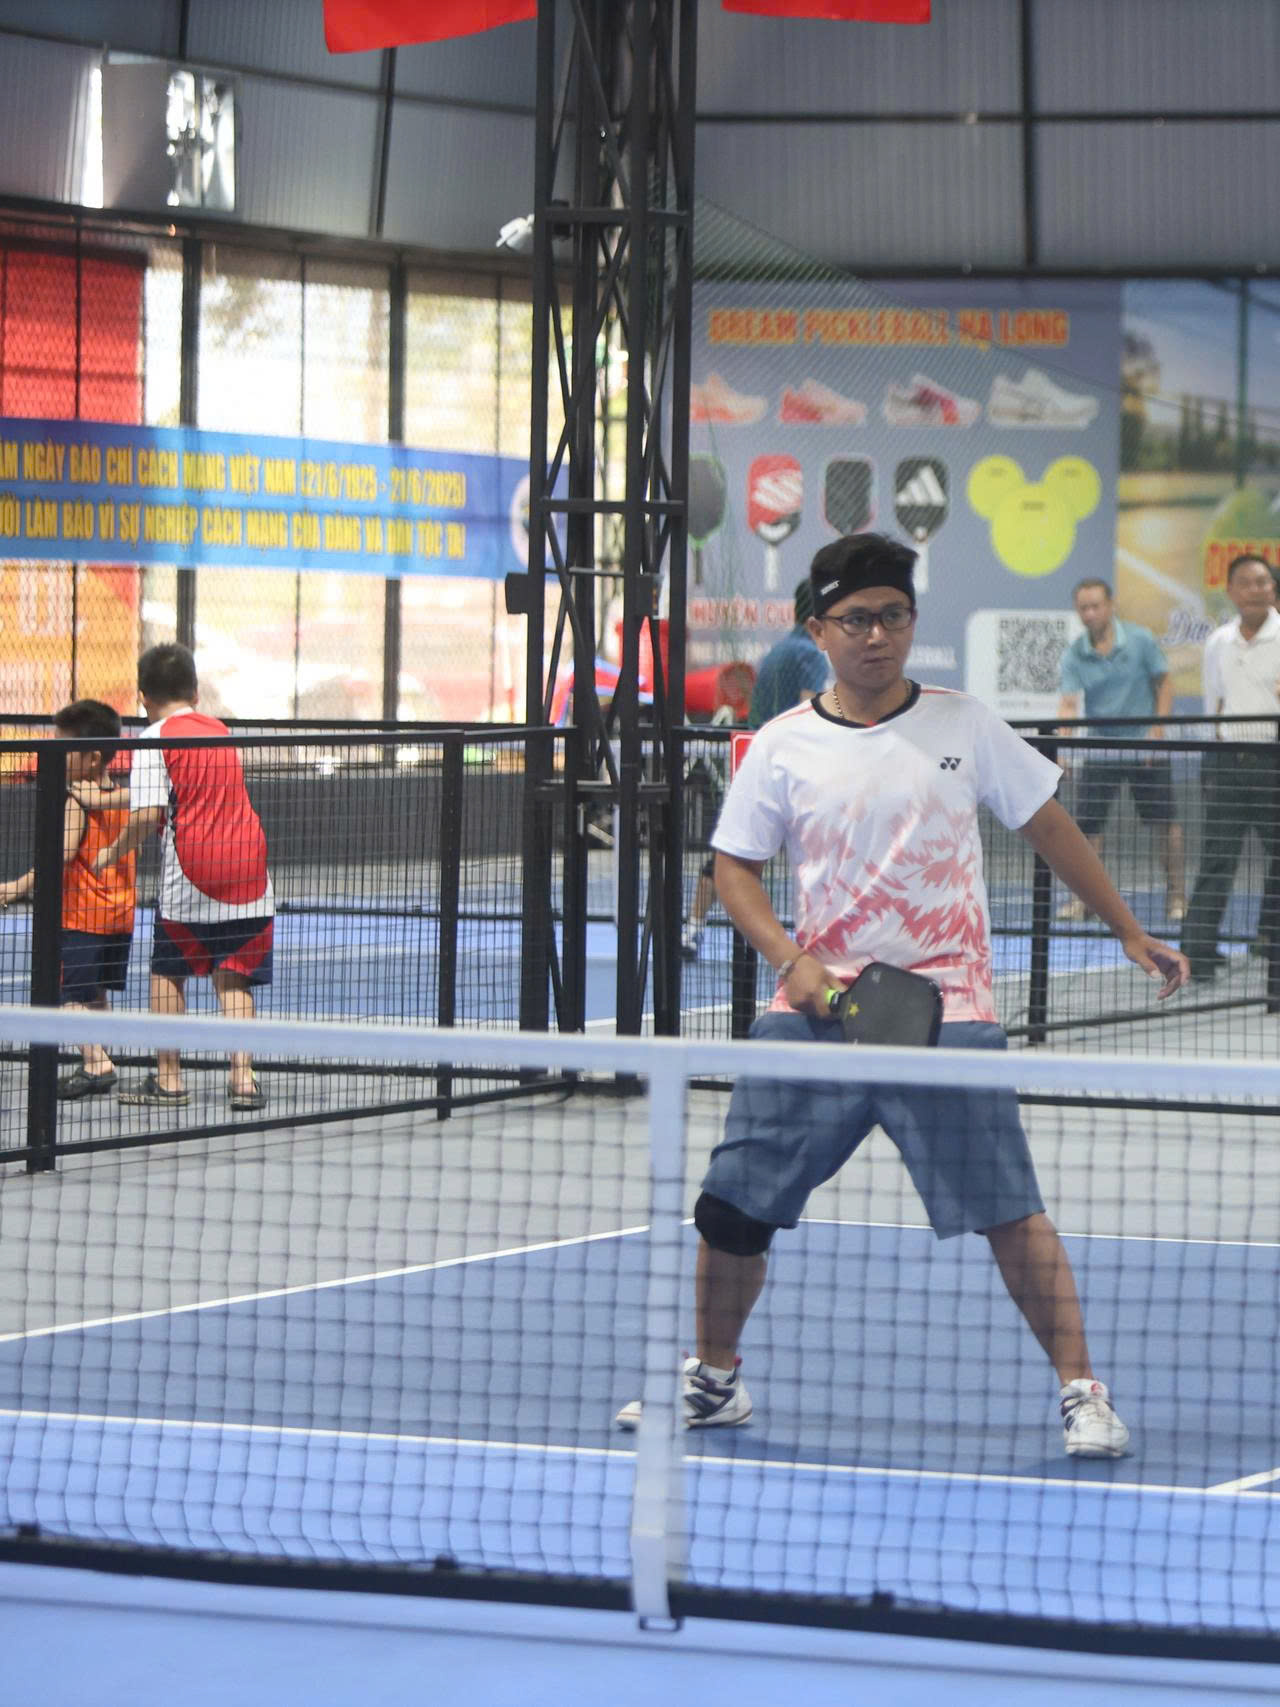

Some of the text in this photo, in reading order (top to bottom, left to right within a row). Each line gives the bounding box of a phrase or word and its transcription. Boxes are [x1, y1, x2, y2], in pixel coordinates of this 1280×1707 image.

[23, 436, 65, 481] NGÀY
[69, 440, 101, 484] BÁO
[106, 440, 133, 485] CHÍ
[137, 444, 178, 488] CÁCH
[182, 451, 226, 495] MẠNG
[229, 449, 260, 496] VIỆT
[263, 458, 295, 495] NAM
[25, 496, 58, 539] LÀM
[62, 498, 94, 541] BÁO
[119, 502, 142, 549] SỰ
[144, 501, 198, 550] NGHIỆP
[202, 506, 242, 546] CÁCH
[246, 509, 288, 554] MẠNG
